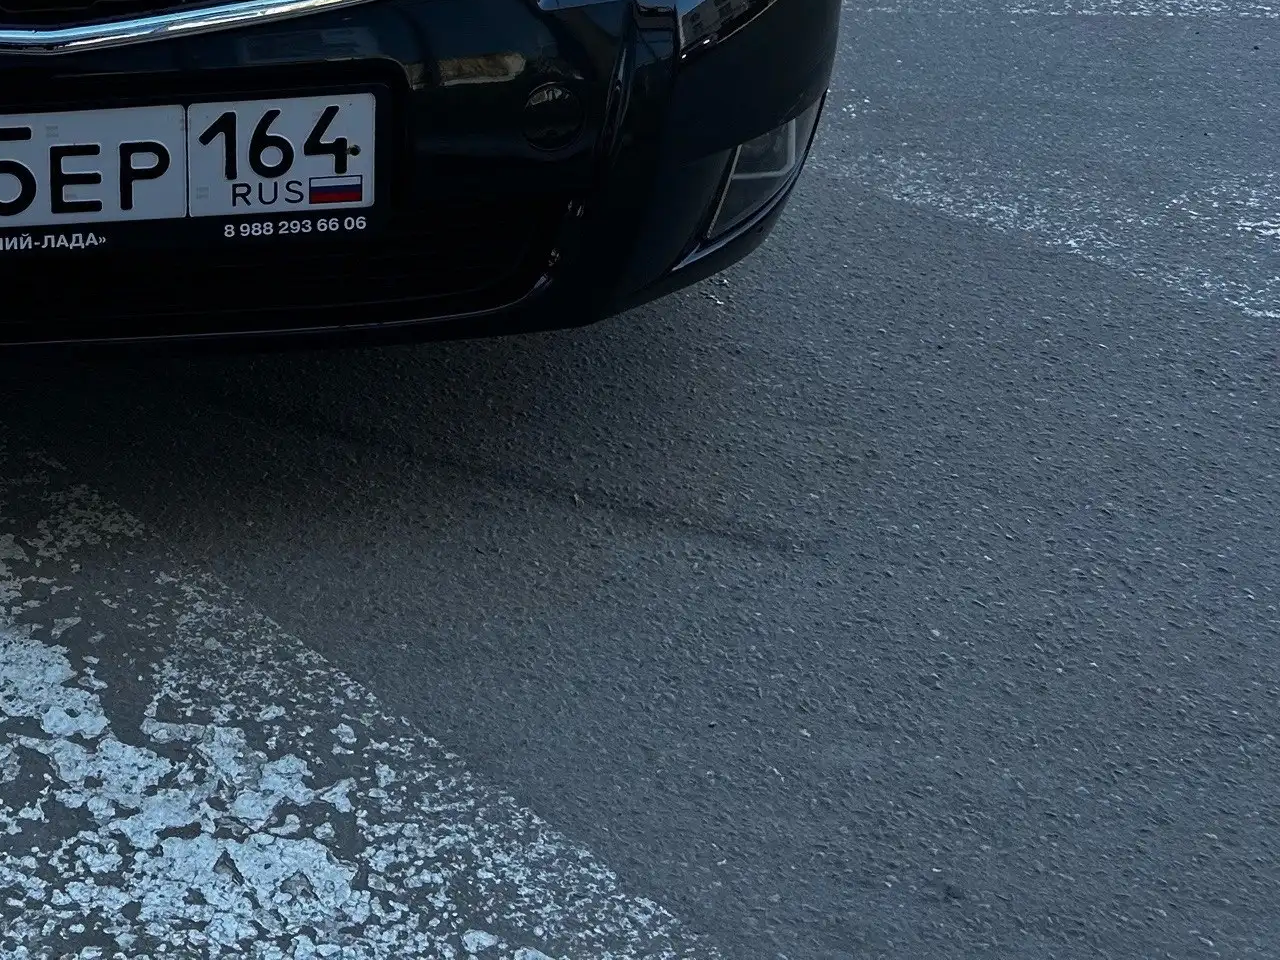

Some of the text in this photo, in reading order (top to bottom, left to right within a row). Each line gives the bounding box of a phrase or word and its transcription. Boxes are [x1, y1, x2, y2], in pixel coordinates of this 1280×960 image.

[198, 105, 348, 181] 164
[232, 181, 304, 207] RUS
[223, 216, 367, 237] 8 988 293 66 06
